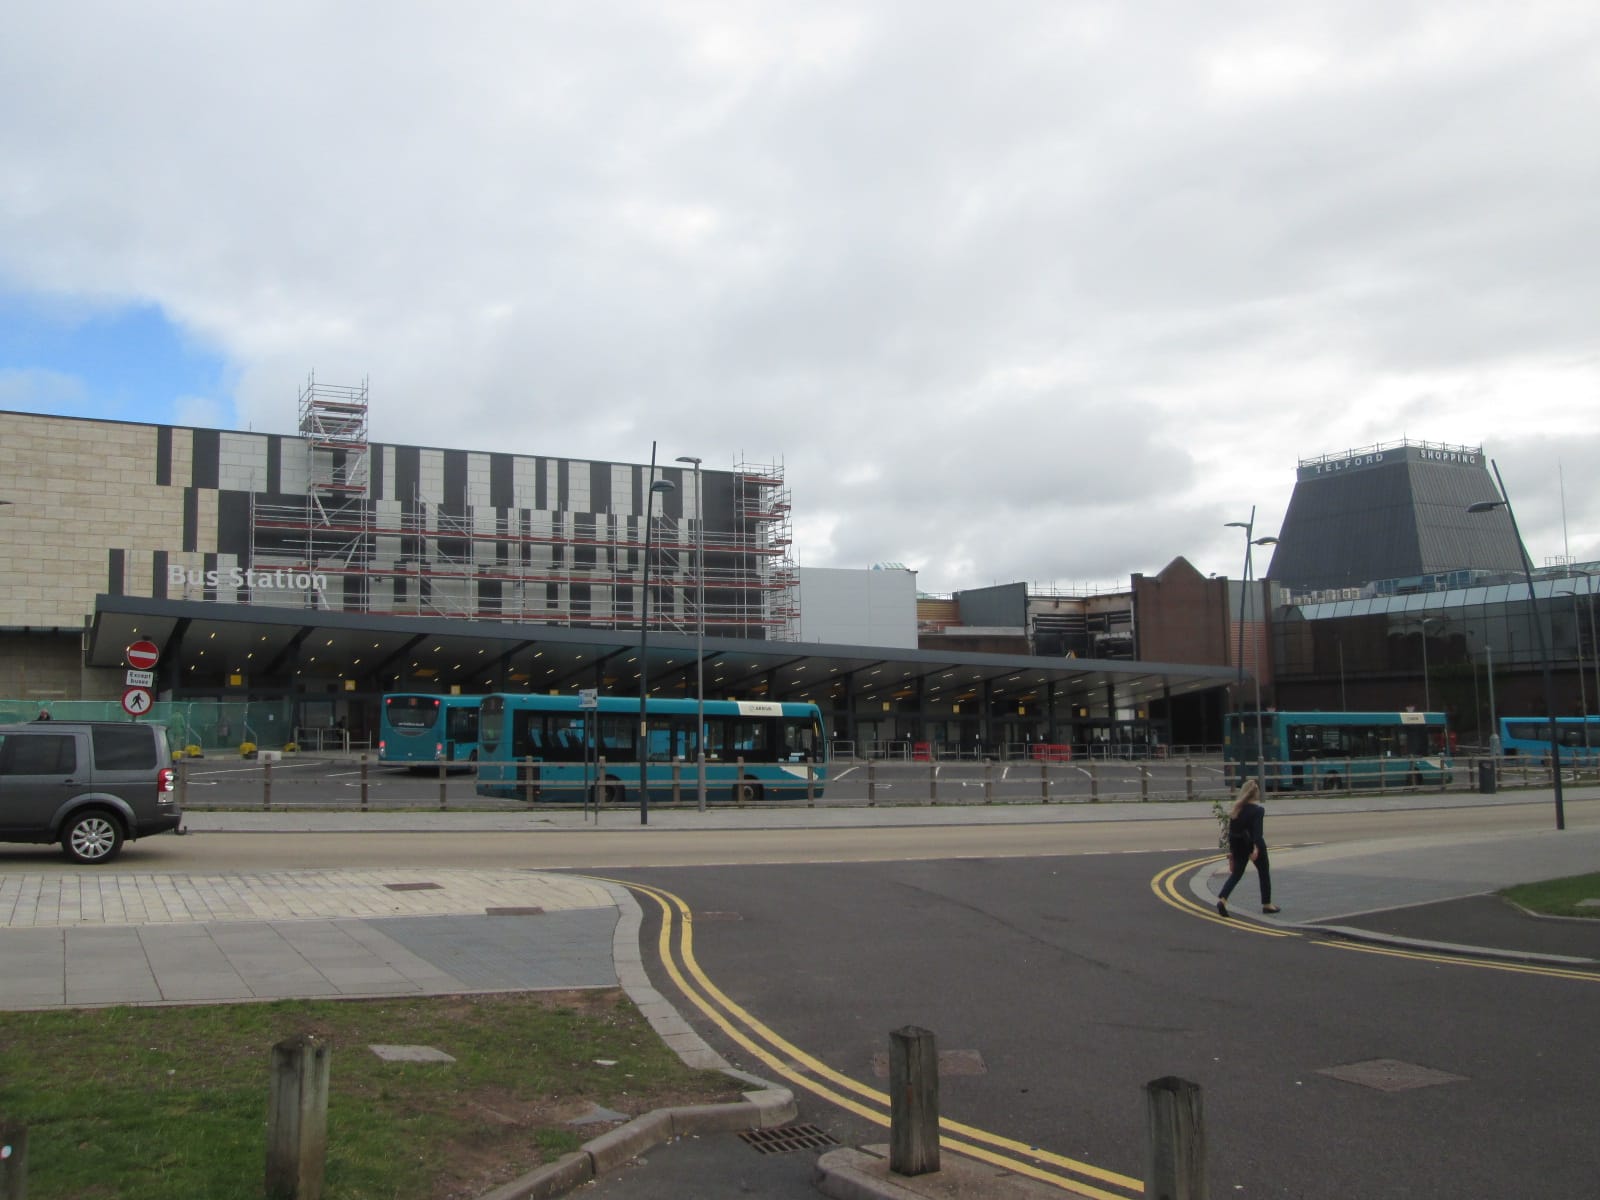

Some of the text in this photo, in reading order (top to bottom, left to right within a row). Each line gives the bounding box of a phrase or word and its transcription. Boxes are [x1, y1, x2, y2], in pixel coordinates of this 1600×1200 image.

[1315, 449, 1476, 474] TELFORD SHOPPING
[167, 564, 328, 590] Bus Station
[129, 671, 151, 680] Except
